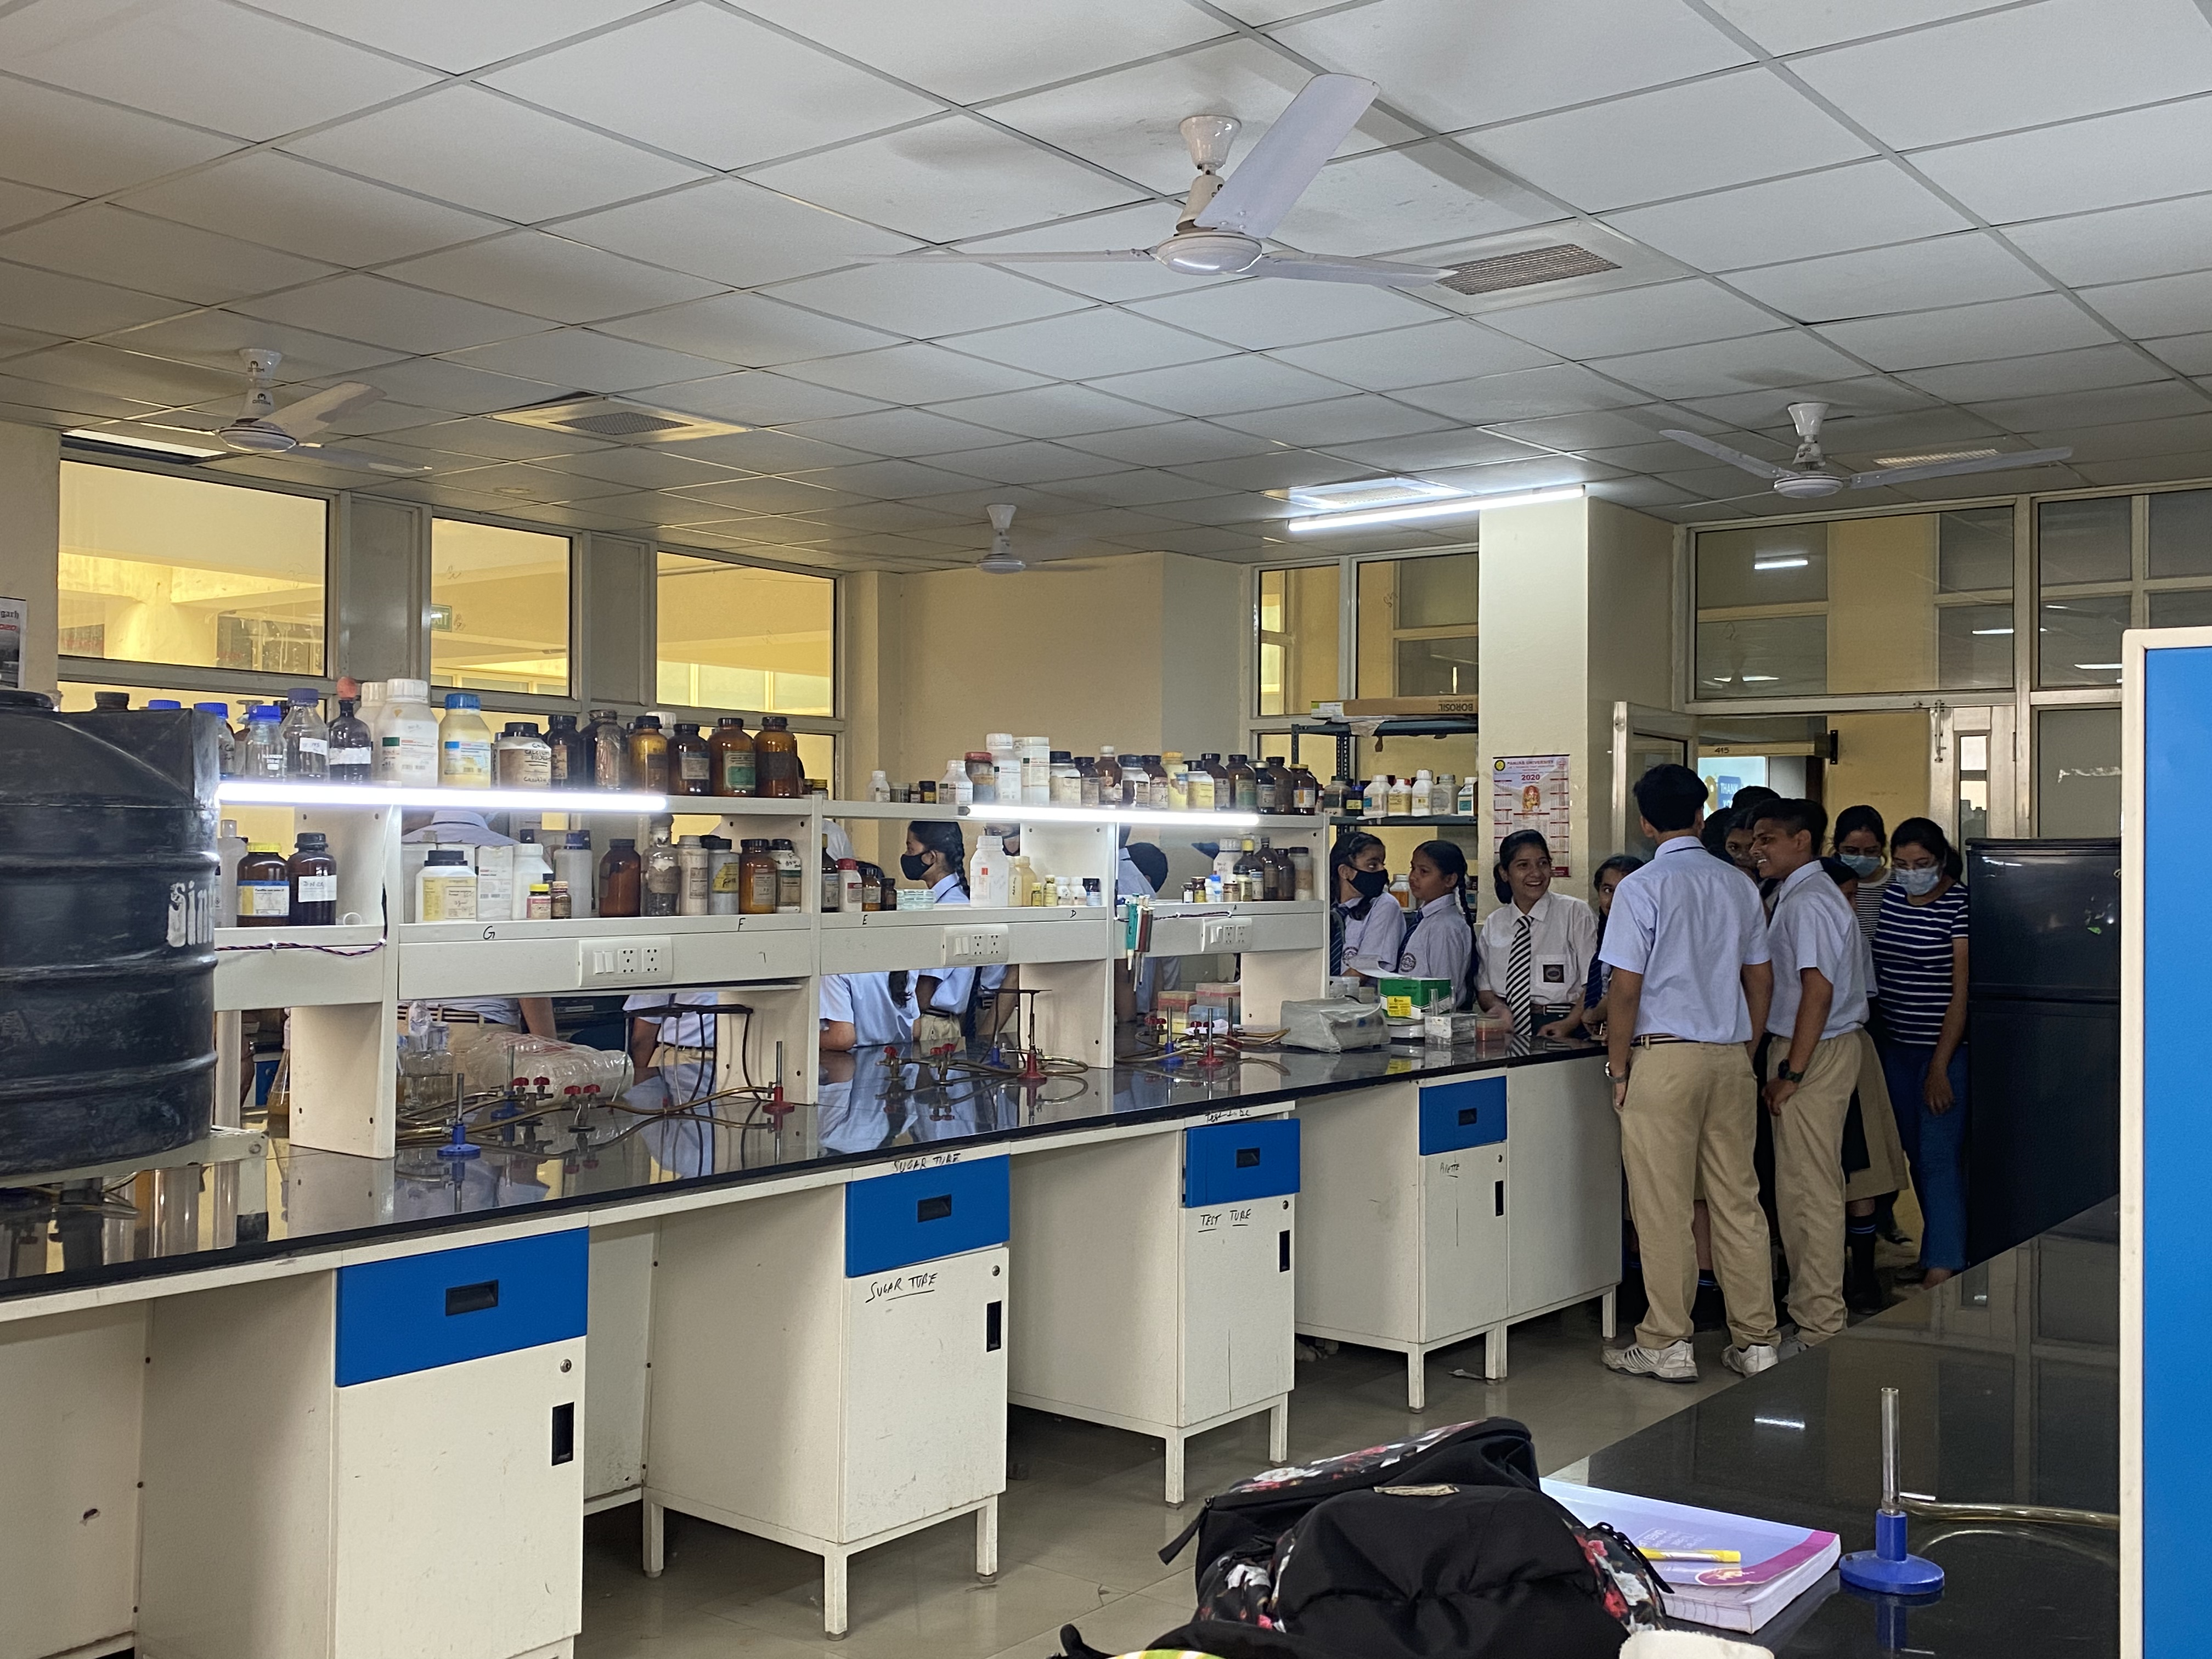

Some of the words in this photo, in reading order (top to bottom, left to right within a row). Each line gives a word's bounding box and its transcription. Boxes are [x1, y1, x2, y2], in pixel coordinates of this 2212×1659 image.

[431, 611, 449, 625] XIT
[1438, 703, 1473, 712] BOROSIL
[1720, 783, 1739, 794] THANK
[1723, 799, 1733, 809] YO
[738, 917, 746, 932] F
[862, 914, 868, 926] E
[483, 926, 495, 940] G
[1200, 1214, 1222, 1226] TEST
[1229, 1209, 1251, 1221] TUBE
[865, 1278, 903, 1303] SUGAR
[908, 1273, 938, 1289] TUBE
